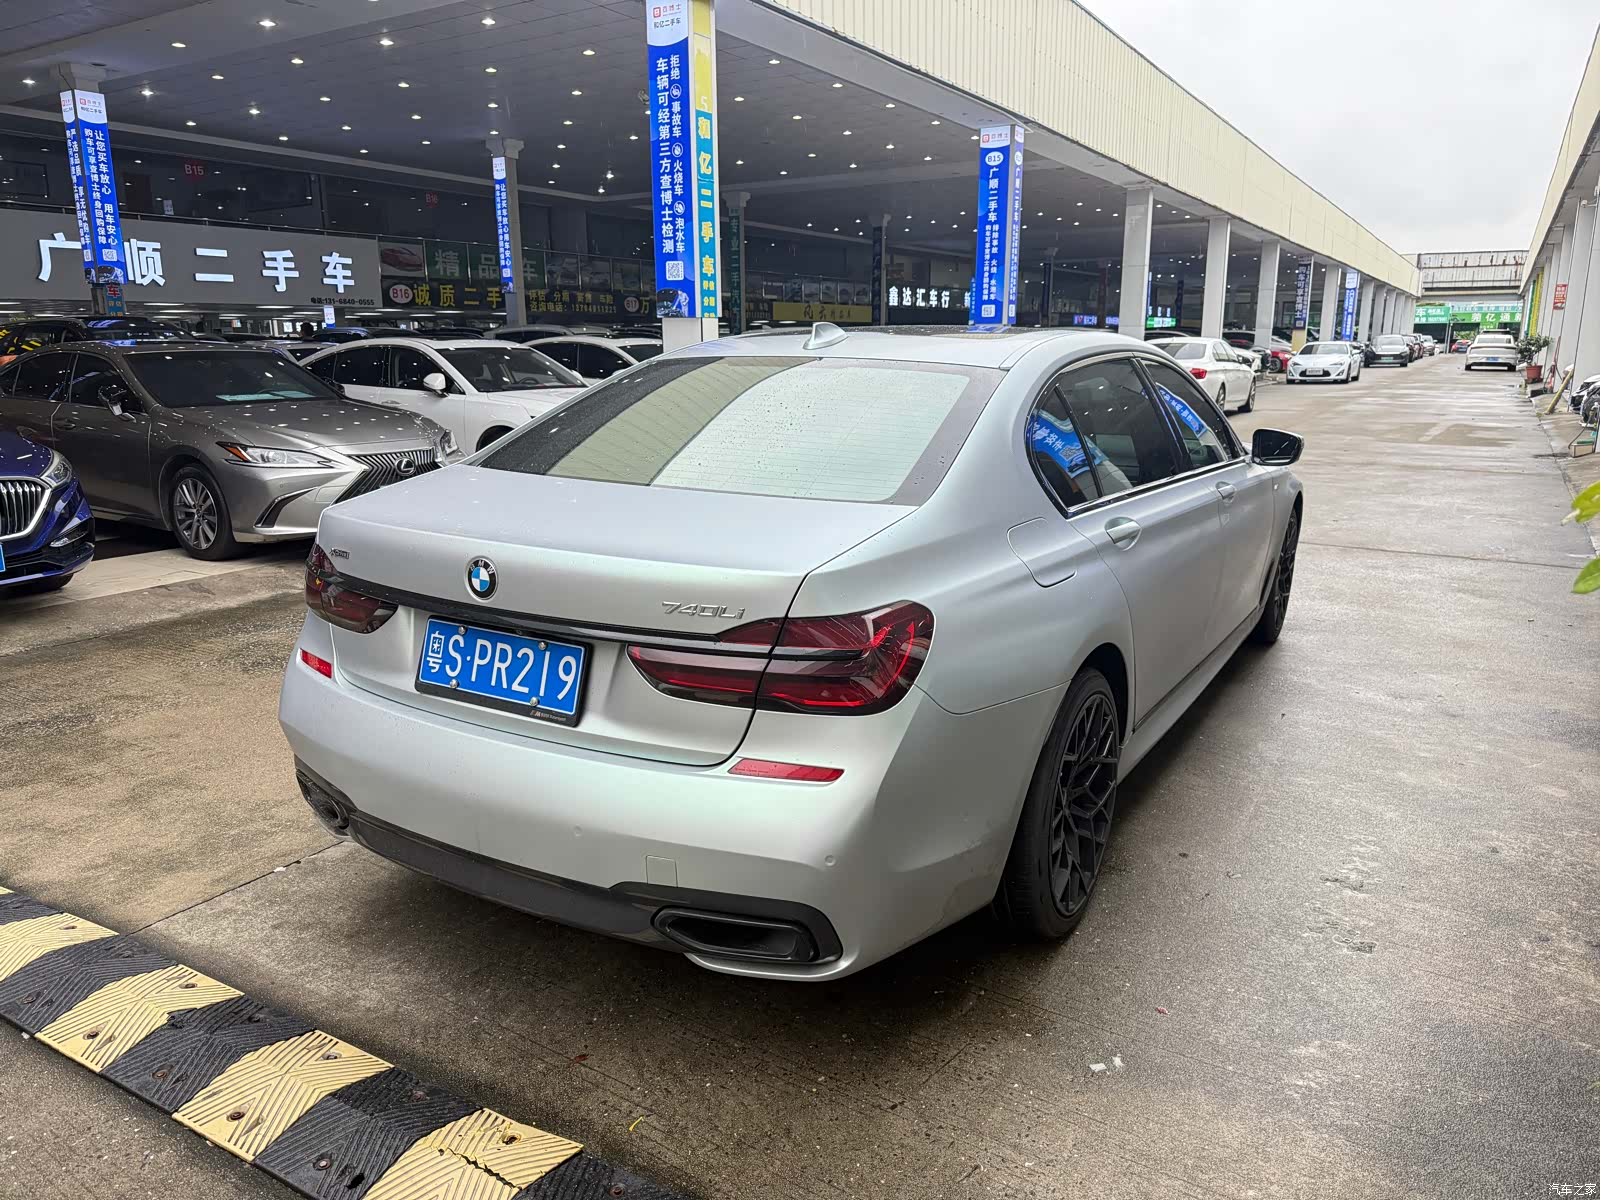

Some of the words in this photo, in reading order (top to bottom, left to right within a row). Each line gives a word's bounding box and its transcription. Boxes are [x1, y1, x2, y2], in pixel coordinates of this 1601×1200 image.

[669, 54, 681, 80] 拒绝
[671, 100, 682, 138] 事故车
[184, 163, 204, 176] B15
[656, 57, 674, 254] 车辆可经第三方查博士检测
[987, 154, 1002, 163] B15
[84, 127, 107, 245] 购车可享查博士终身回购保障
[94, 129, 112, 194] 让您买车放心
[103, 203, 118, 246] 用车安心
[673, 159, 684, 196] 火烧车
[988, 166, 999, 222] 广顺二手车
[675, 217, 686, 254] 泡水车
[38, 232, 355, 294] 广顺二手车
[391, 287, 410, 300] B16
[413, 283, 502, 309] 诚质二手
[888, 285, 950, 309] 鑫达汇车行
[661, 600, 746, 620] 740Li
[426, 630, 577, 700] 粤S·PR219
